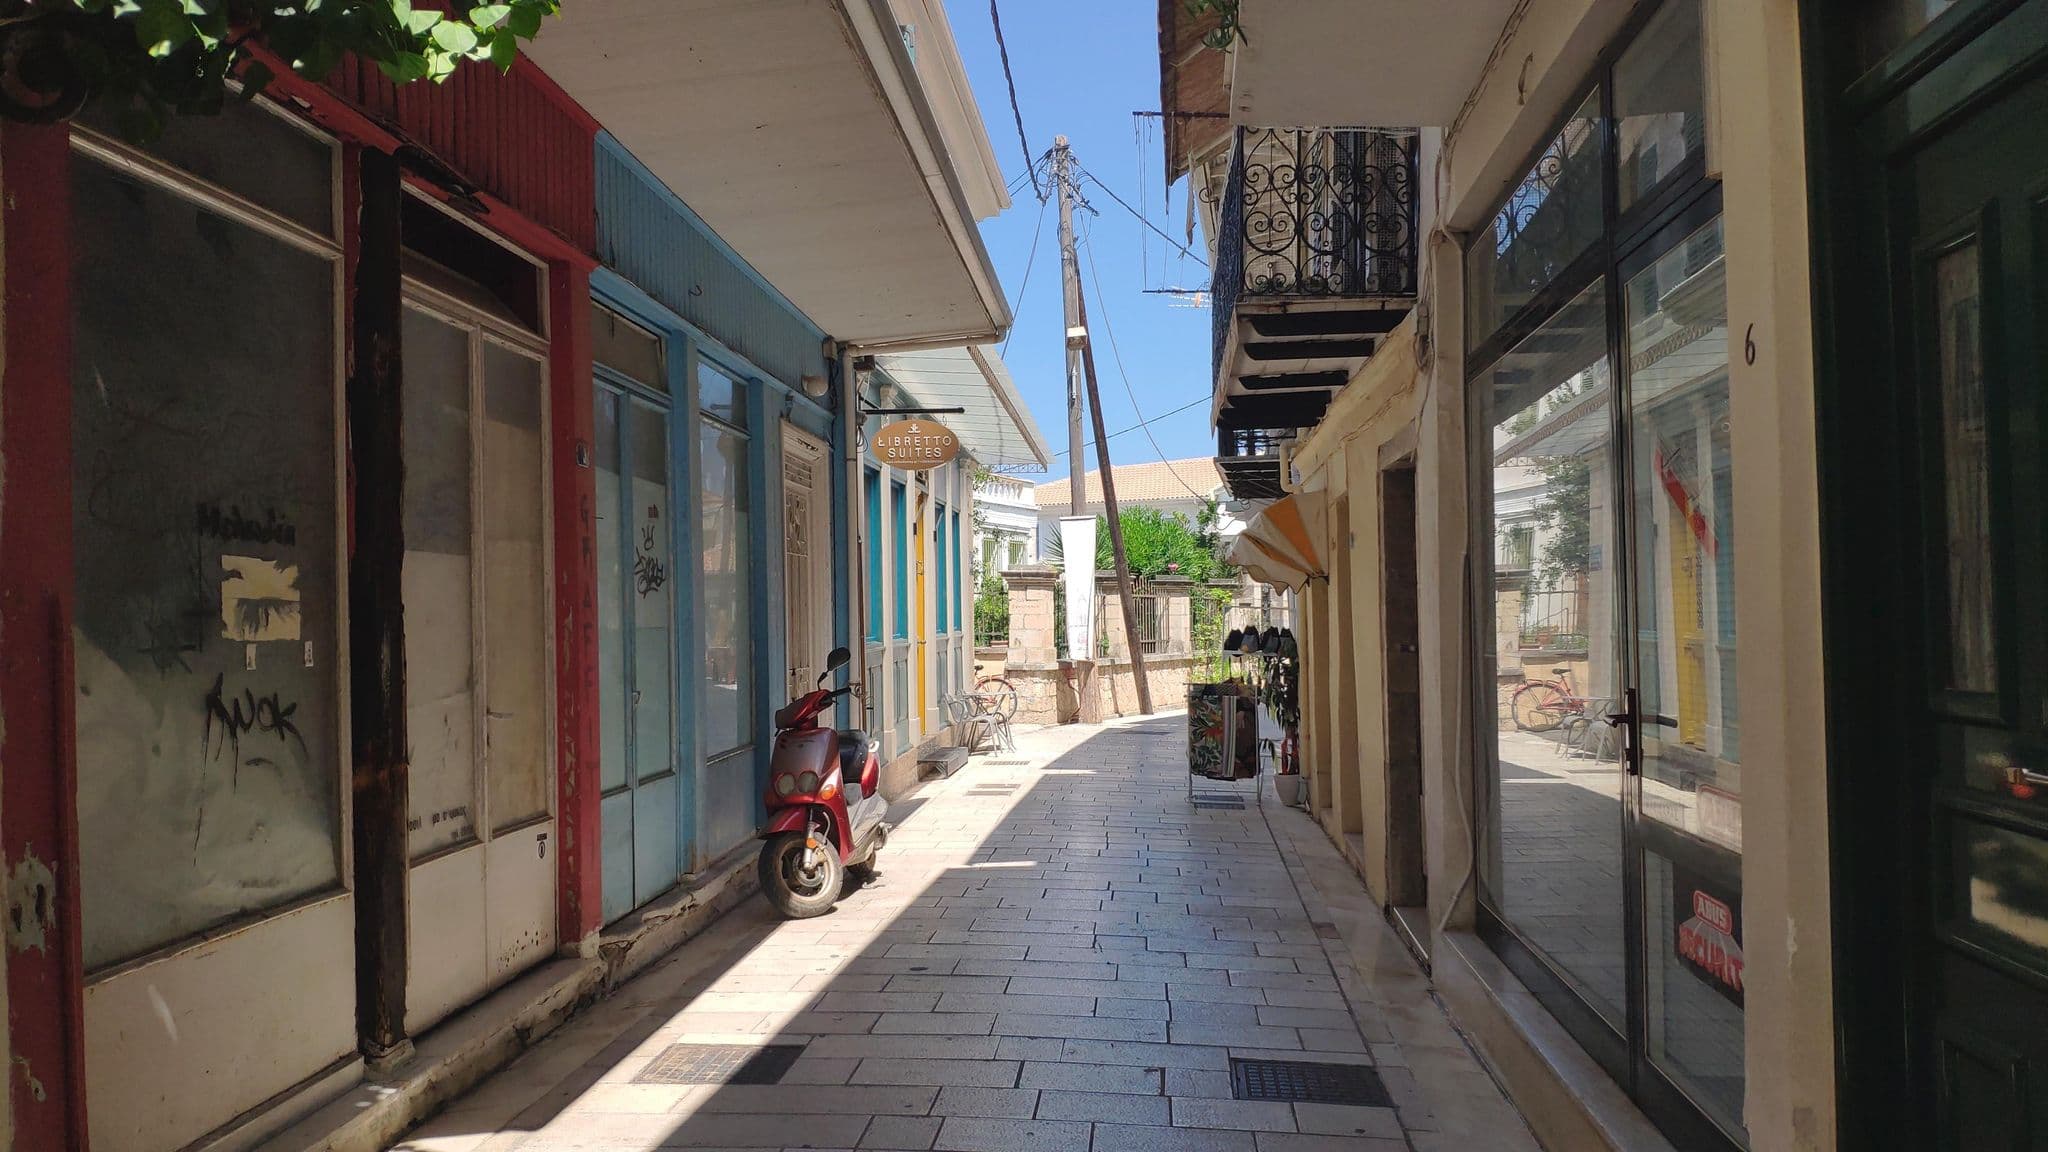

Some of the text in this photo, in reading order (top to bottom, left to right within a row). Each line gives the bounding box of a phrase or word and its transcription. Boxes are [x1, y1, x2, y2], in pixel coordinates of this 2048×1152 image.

[1746, 323, 1755, 366] 6
[878, 436, 952, 447] LIBRETTO
[887, 448, 943, 458] SUITES
[1680, 925, 1745, 992] SECURIT
